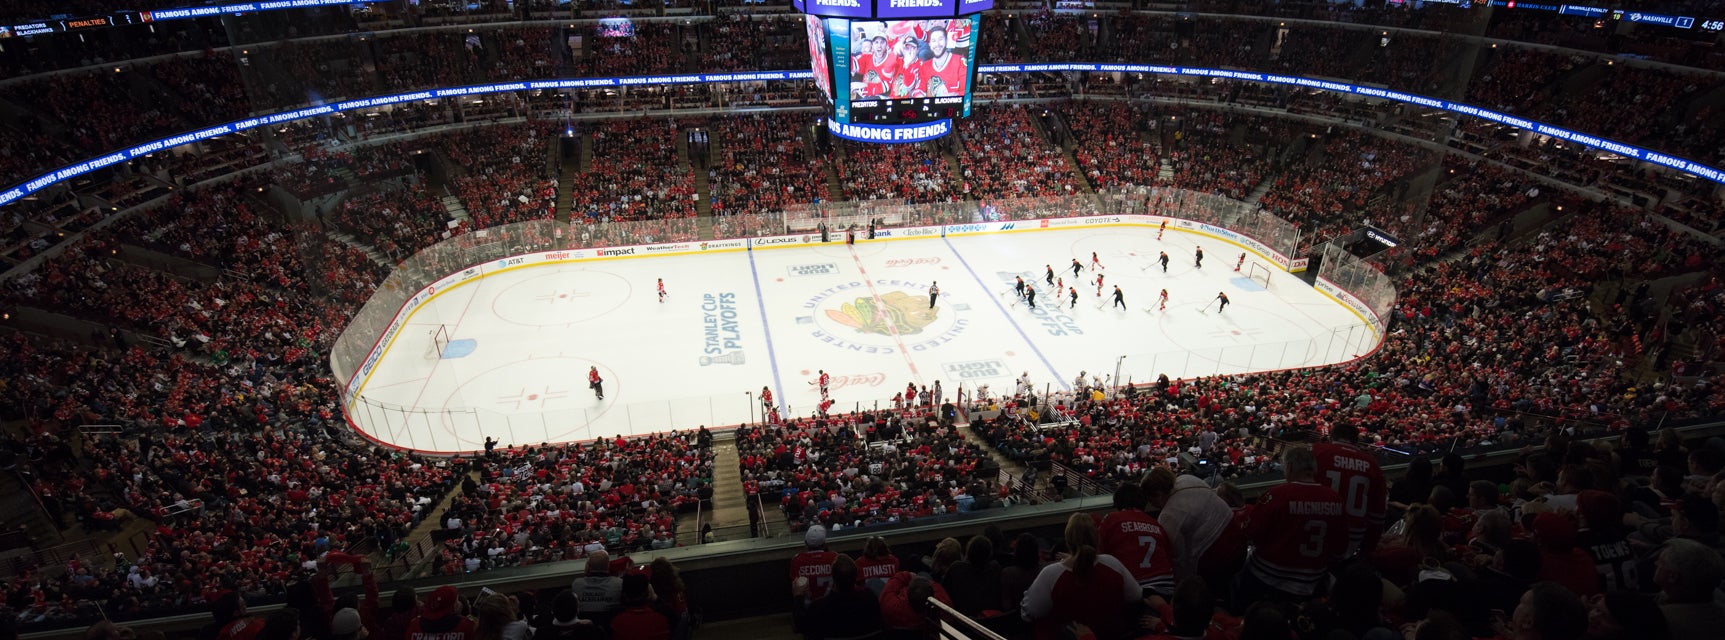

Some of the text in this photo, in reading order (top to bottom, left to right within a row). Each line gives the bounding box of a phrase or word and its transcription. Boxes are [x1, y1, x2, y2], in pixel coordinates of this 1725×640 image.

[155, 8, 190, 18] FAMOUS
[221, 4, 256, 13] FRIENDS.
[261, 1, 291, 9] FAMOUS
[69, 19, 106, 28] PENALTIES
[1642, 15, 1673, 24] NASHVILLE
[1702, 20, 1724, 30] 4:56
[16, 28, 54, 36] BLACKHAWKS
[1209, 69, 1233, 77] AMONG
[1234, 72, 1263, 80] FRIENDS.
[1267, 75, 1352, 92] FAMOUS AMONG FRIENDS.
[437, 88, 467, 96] FAMOUS
[1356, 87, 1442, 108] FAMOUS AMONG FRIENDS.
[338, 92, 432, 110] FAMOUS AMONG FRIENDS.
[236, 106, 334, 129] FAMOUS AMONG FRIENDS.
[1448, 103, 1533, 130] FAMOUS AMONG FRIENDS.
[842, 124, 891, 140] AMONG
[894, 122, 947, 139] FRIENDS.
[130, 126, 231, 156] FAMOUS AMONG FRIENDS.
[1538, 124, 1639, 157] FAMOUS AMONG FRIENDS.
[26, 153, 126, 191] FAMOUS AMONG FRIENDS.
[1646, 152, 1685, 169] FAMOUS
[1686, 162, 1717, 179] AMONG
[1246, 239, 1257, 249] CME
[1375, 235, 1396, 247] HYUNDAI
[546, 252, 570, 261] meijer
[604, 248, 634, 257] impact
[791, 263, 834, 272] LIGHT
[885, 257, 941, 267] Coca-Cola
[804, 279, 951, 309] UNITED CENTR
[702, 293, 722, 354] STANLEY CUP
[719, 292, 742, 349] PLAYOFFS
[812, 319, 968, 354] UNITED CENTER
[363, 344, 382, 376] GEICO
[949, 361, 1002, 372] LIGHT
[959, 368, 1000, 378] BUD
[1334, 456, 1371, 472] SHARP
[520, 470, 528, 480] 72
[1326, 471, 1370, 517] 10
[1289, 500, 1342, 516] MAGNUSON
[1121, 521, 1161, 534] SEABROOK
[1299, 520, 1327, 557] 3
[1138, 536, 1157, 568] 7
[1591, 541, 1630, 560] TOEWS
[799, 565, 832, 576] SECOND
[862, 565, 895, 577] DYNASTY
[411, 632, 465, 640] CRAWFORD
